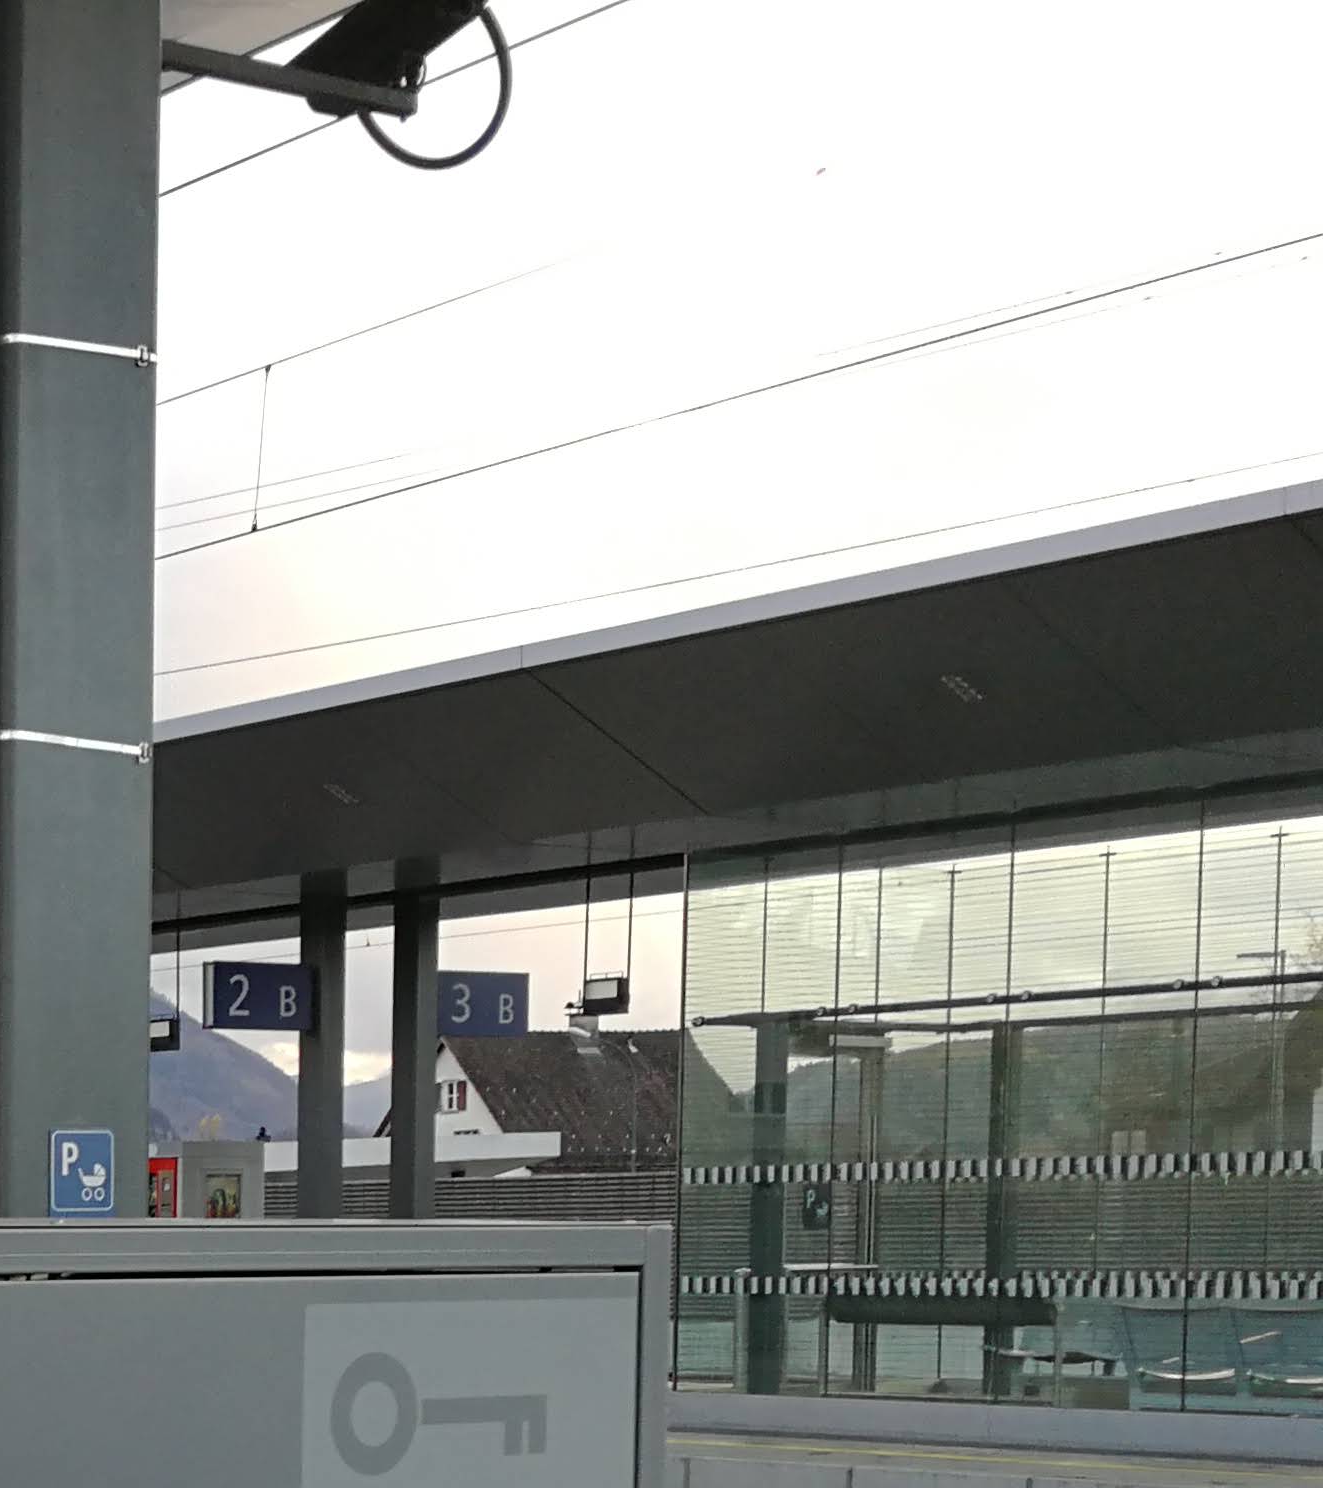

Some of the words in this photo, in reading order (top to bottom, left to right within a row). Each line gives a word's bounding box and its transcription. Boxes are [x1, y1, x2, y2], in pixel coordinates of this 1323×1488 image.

[228, 974, 250, 1017] 2
[279, 986, 297, 1017] B
[451, 983, 471, 1024] 3
[498, 993, 514, 1024] B
[61, 1142, 79, 1176] P
